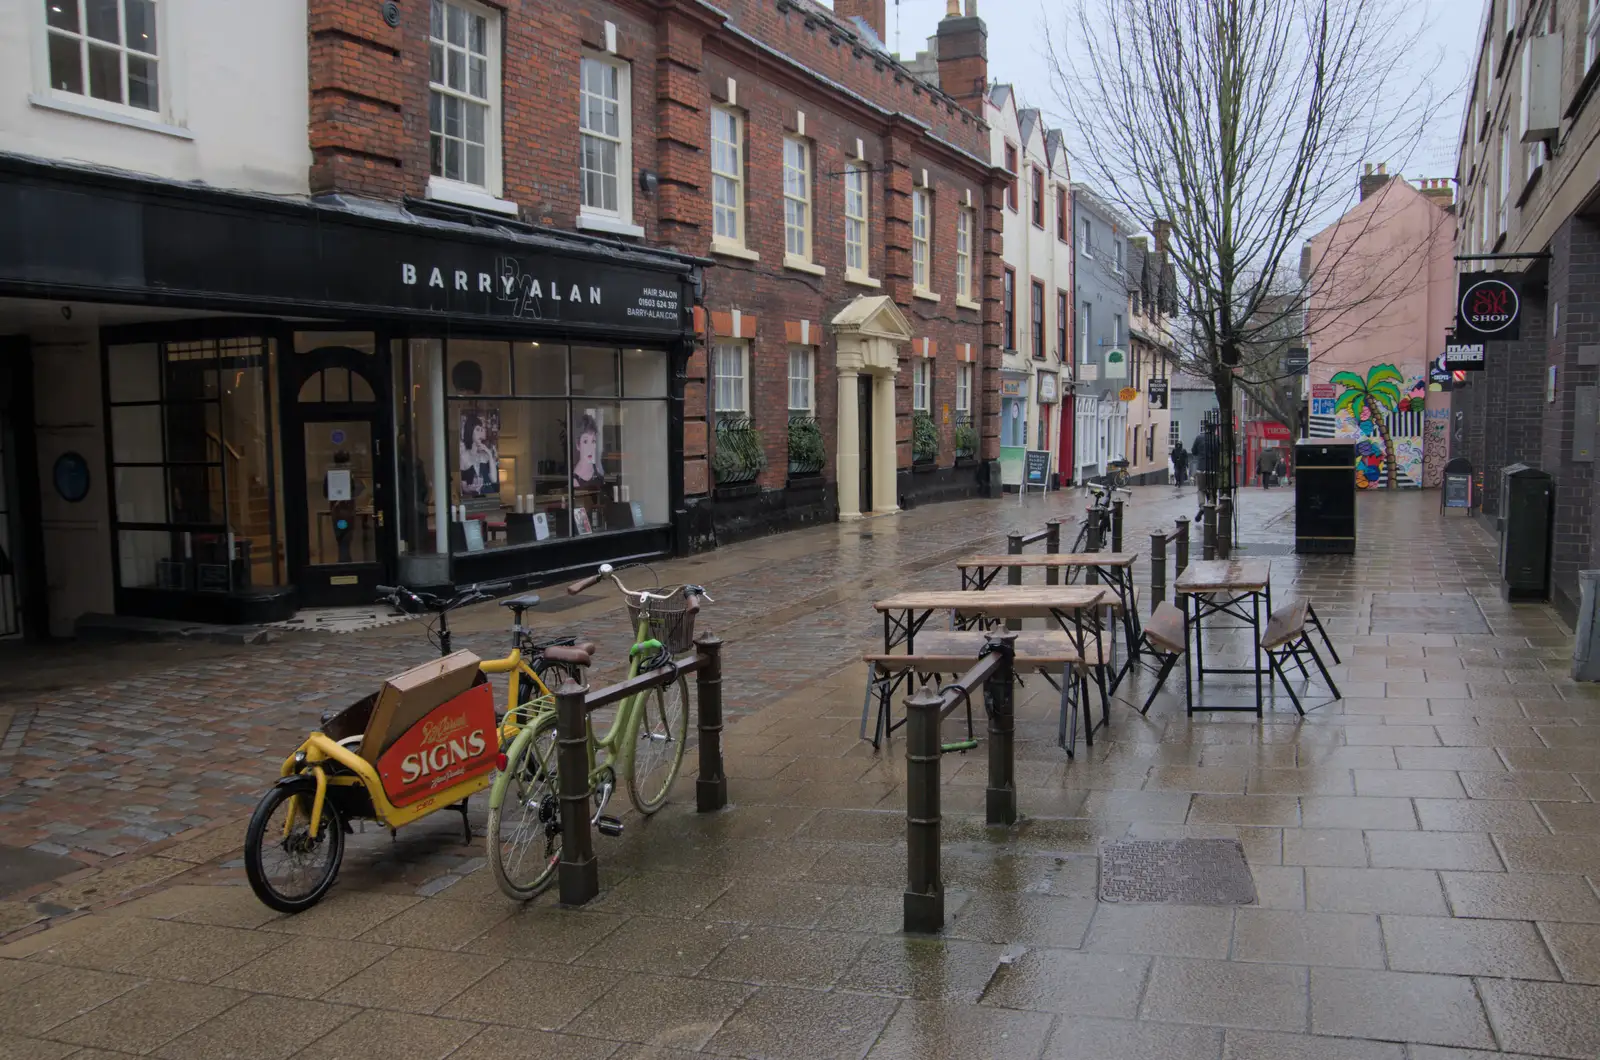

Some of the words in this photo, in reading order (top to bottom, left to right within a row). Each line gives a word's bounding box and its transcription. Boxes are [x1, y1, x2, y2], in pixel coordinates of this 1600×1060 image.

[402, 262, 516, 296] BARRY
[530, 278, 602, 305] ALAN
[643, 287, 658, 297] HAIR
[658, 289, 678, 300] SALON
[656, 300, 667, 309] 624
[667, 301, 678, 310] 397
[627, 307, 678, 320] BARRY-ALAN.COM
[1471, 314, 1509, 322] SHOP
[1447, 344, 1484, 353] MAIN
[1447, 354, 1484, 362] SOURCE
[401, 729, 486, 784] SIGNS
